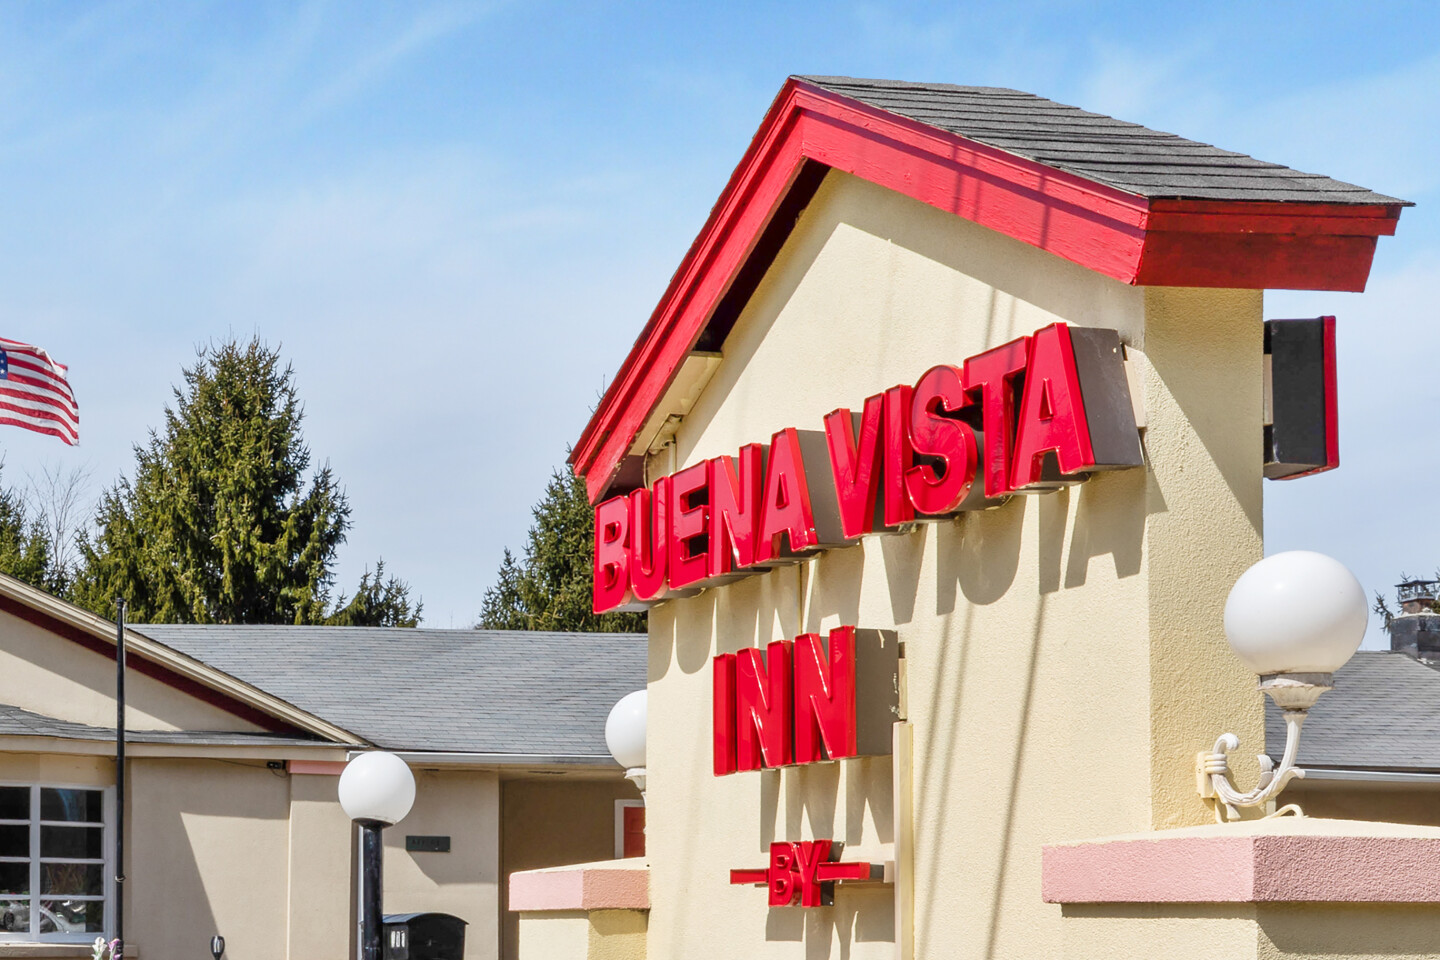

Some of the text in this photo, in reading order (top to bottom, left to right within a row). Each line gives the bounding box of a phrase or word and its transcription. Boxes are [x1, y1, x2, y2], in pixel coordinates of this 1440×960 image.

[593, 322, 1097, 614] BUENA VISTA
[713, 625, 858, 777] INN
